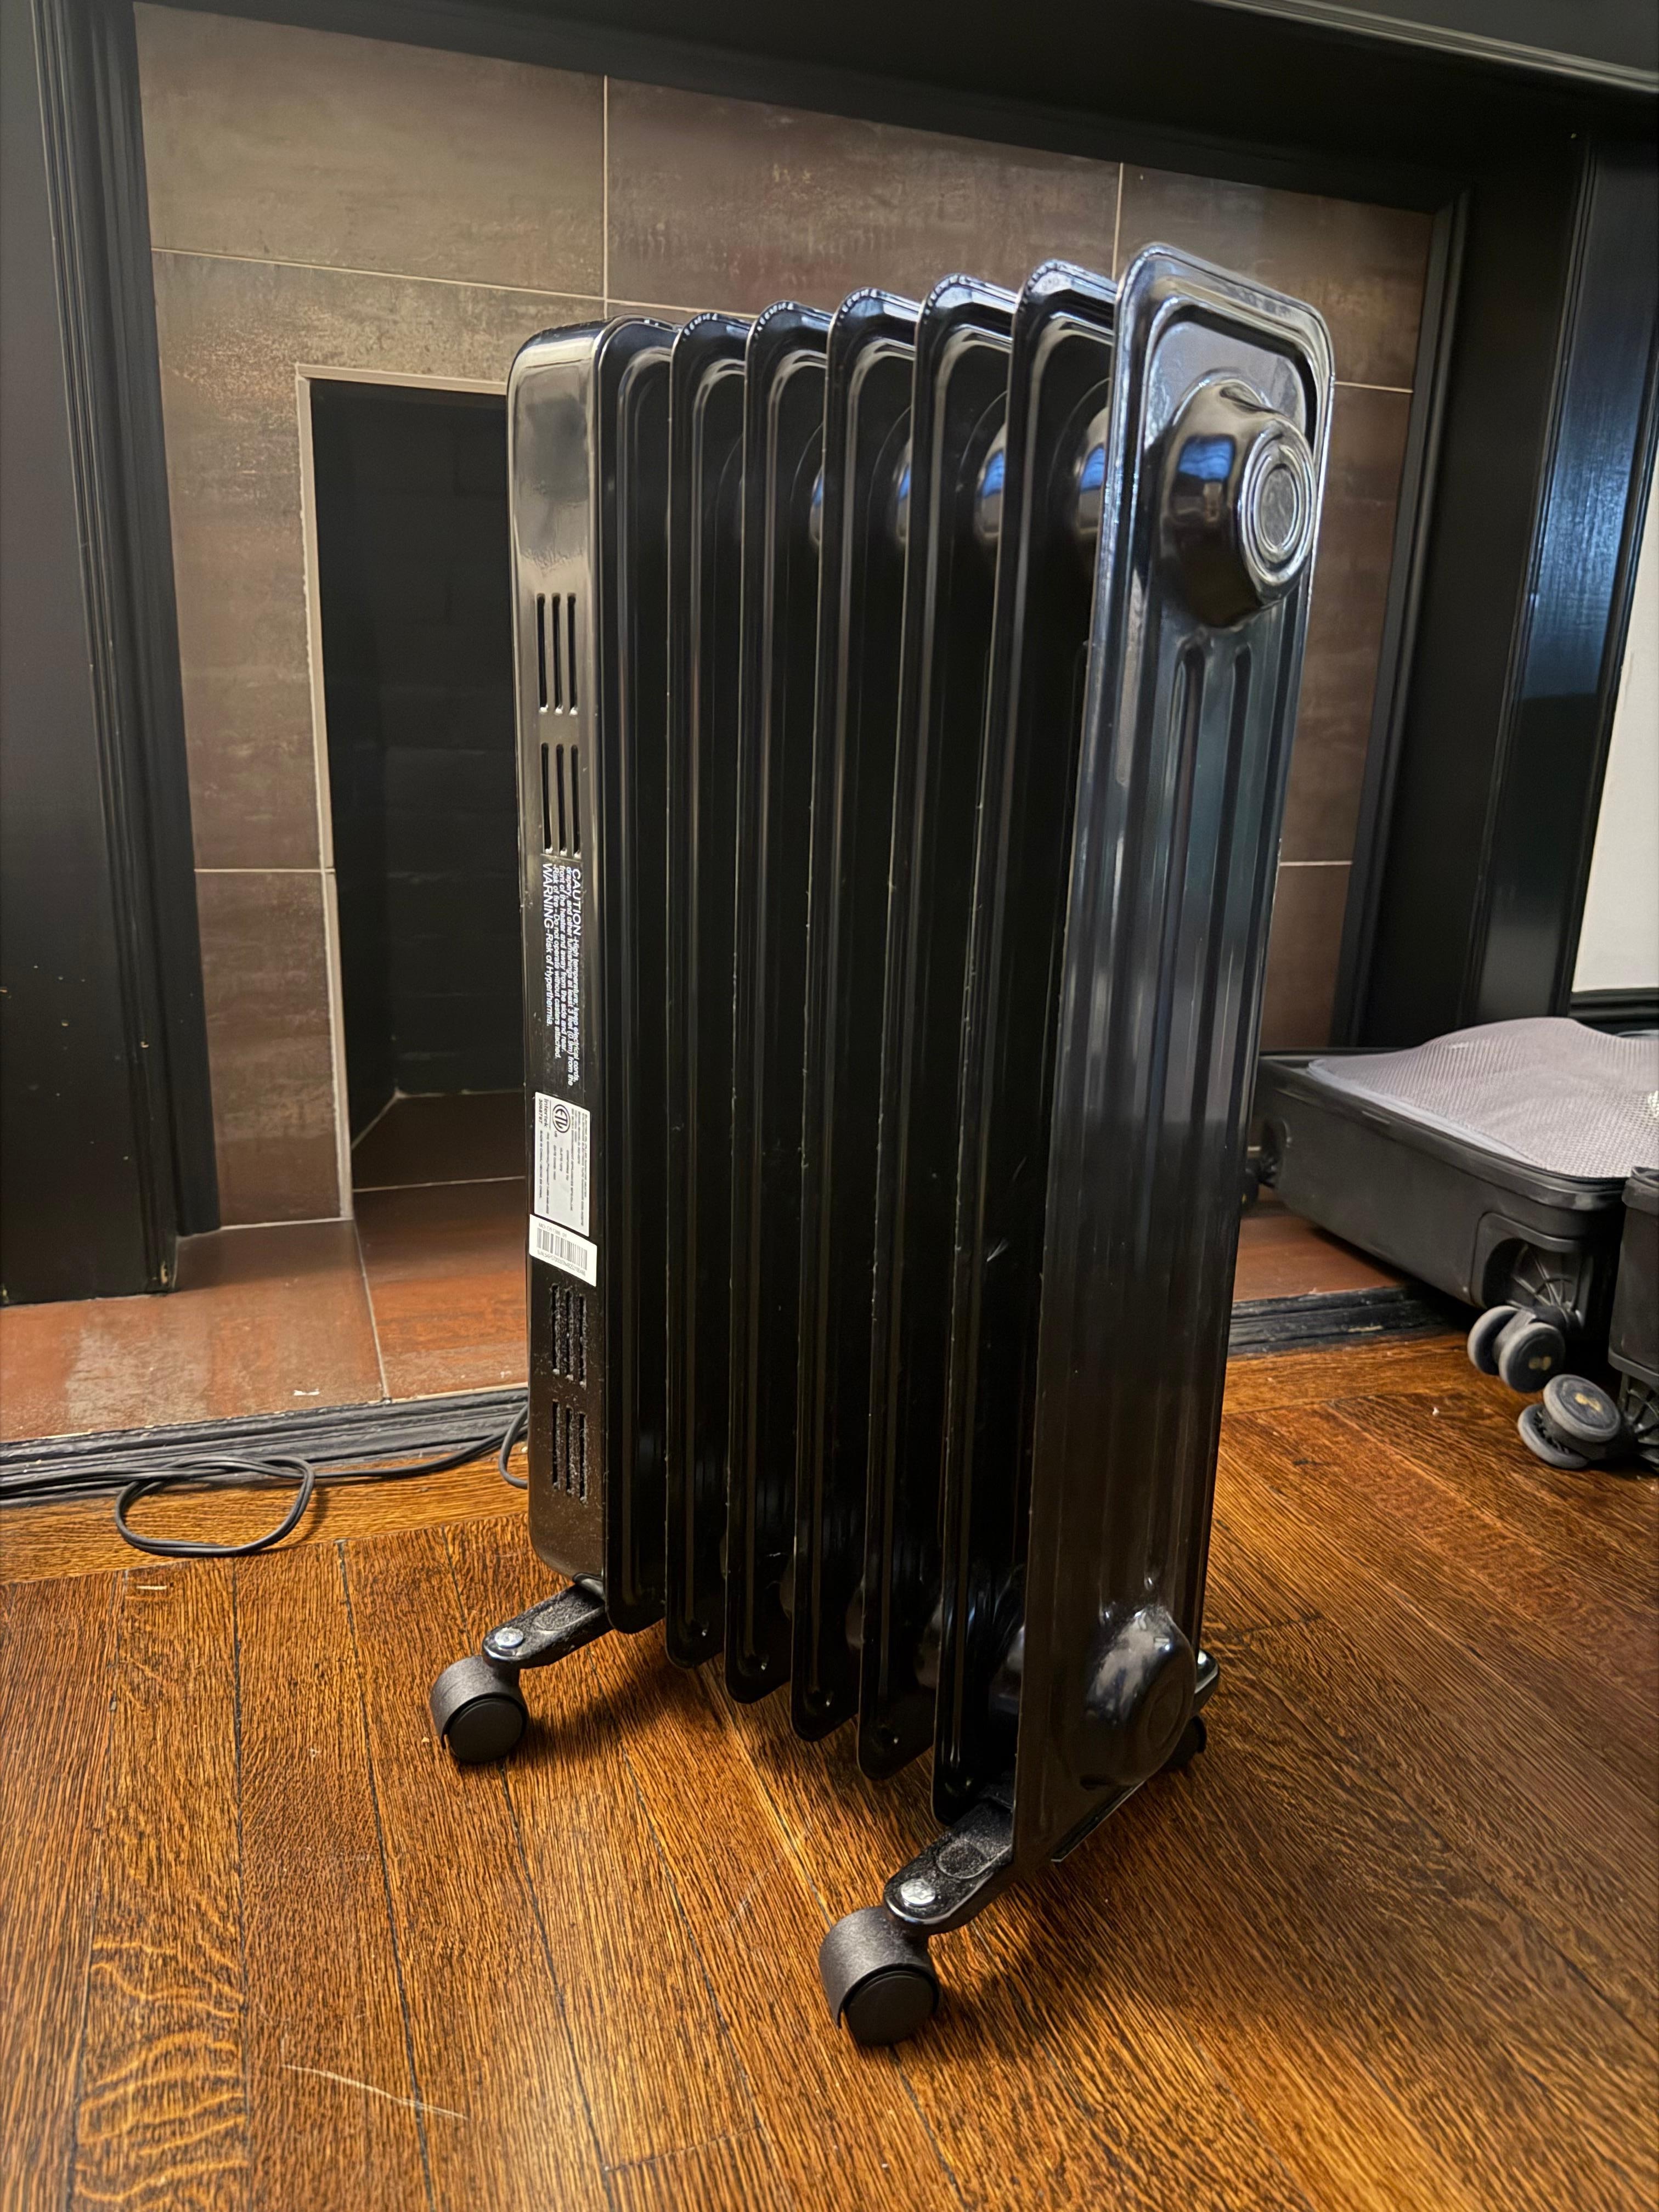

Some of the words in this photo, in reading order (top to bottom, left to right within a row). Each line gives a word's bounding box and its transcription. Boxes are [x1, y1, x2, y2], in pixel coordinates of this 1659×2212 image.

[554, 885, 560, 894] of
[560, 884, 566, 893] of
[543, 863, 554, 929] WARNING
[554, 914, 560, 925] Do
[546, 955, 553, 964] of
[544, 966, 554, 1026] Hyperthermia.
